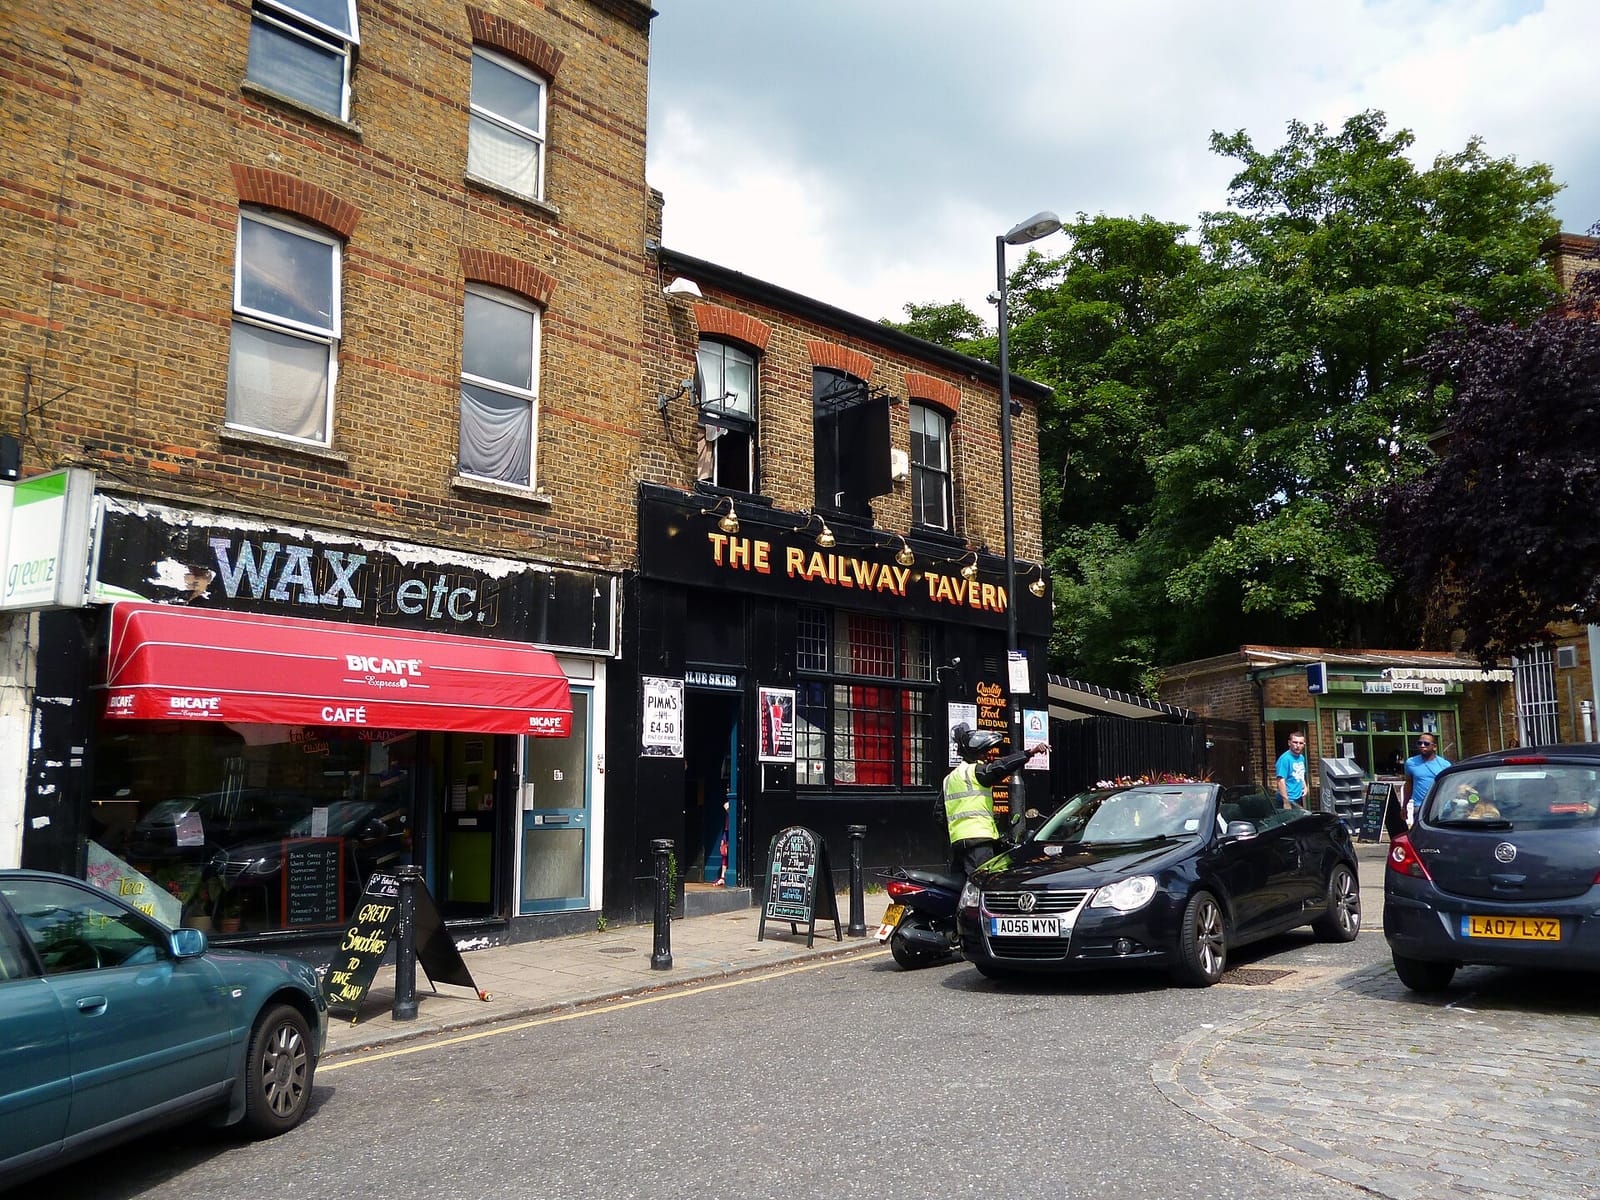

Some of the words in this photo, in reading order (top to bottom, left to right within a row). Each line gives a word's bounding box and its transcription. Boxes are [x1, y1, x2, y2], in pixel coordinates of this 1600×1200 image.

[708, 532, 771, 574] THE
[786, 547, 911, 597] RAILWAY
[6, 556, 57, 598] greenz
[209, 537, 367, 609] WAX
[396, 574, 485, 622] etc.
[708, 673, 737, 688] SKIES
[1393, 682, 1420, 690] COFFEE
[1424, 686, 1443, 694] SHOP
[976, 681, 1002, 698] Quality
[976, 697, 1007, 708] OMEMADE
[321, 706, 367, 724] CAFÉ
[980, 706, 1000, 719] Food
[650, 721, 675, 734] £4.50
[117, 876, 144, 896] Tea
[358, 904, 395, 924] GREAT
[1000, 920, 1028, 933] AO56
[1032, 920, 1057, 933] MYN
[1472, 918, 1516, 936] LA07
[1522, 920, 1558, 937] LXZ
[347, 957, 361, 970] TO
[331, 971, 353, 985] TAKE
[340, 984, 364, 1000] AWAY
